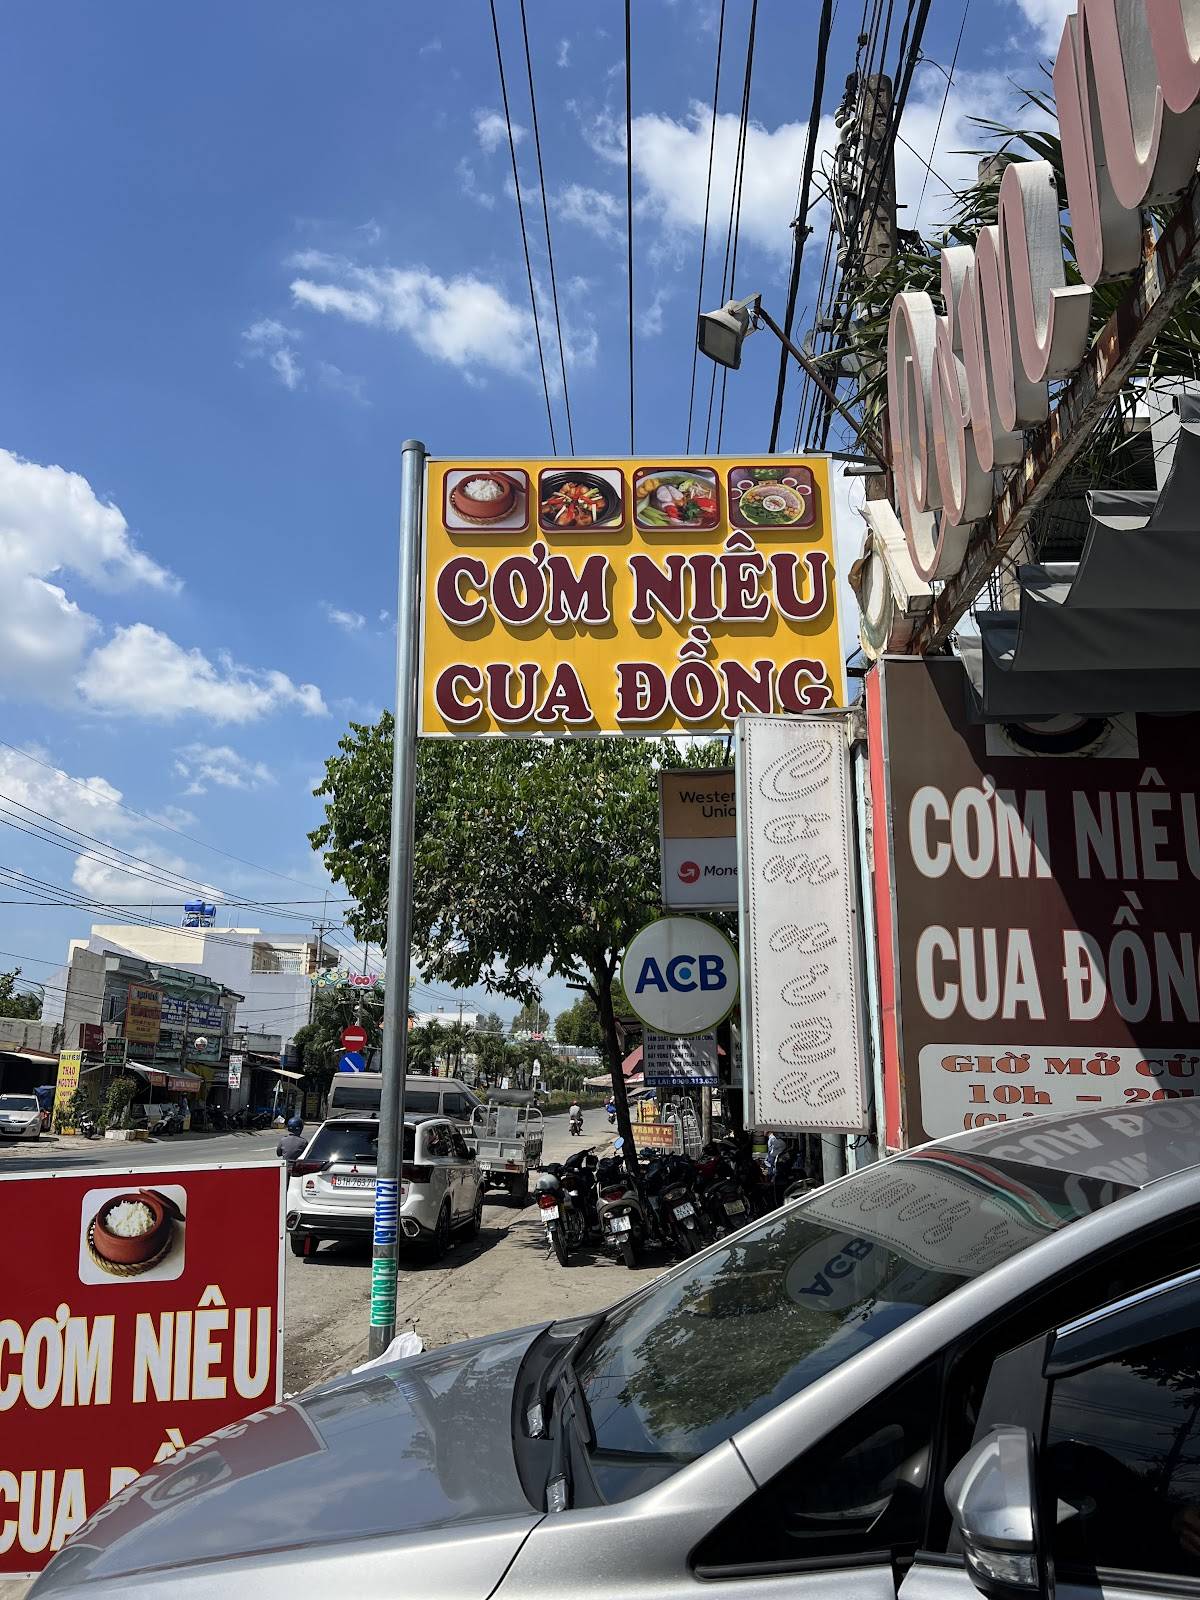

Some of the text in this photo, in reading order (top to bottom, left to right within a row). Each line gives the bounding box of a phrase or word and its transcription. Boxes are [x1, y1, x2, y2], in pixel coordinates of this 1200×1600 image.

[435, 529, 829, 626] CƠM NIÊU
[434, 625, 832, 724] CUA ĐỒNG
[908, 773, 1053, 880] CƠM
[634, 954, 727, 994] ACB
[916, 890, 1200, 1023] CUA ĐỒN
[941, 1051, 1031, 1074] GIỜ
[1044, 1052, 1121, 1076] MỞ
[968, 1084, 1053, 1105] 10h
[0, 1284, 272, 1411] CƠM NIÊU
[0, 1467, 88, 1554] CUA
